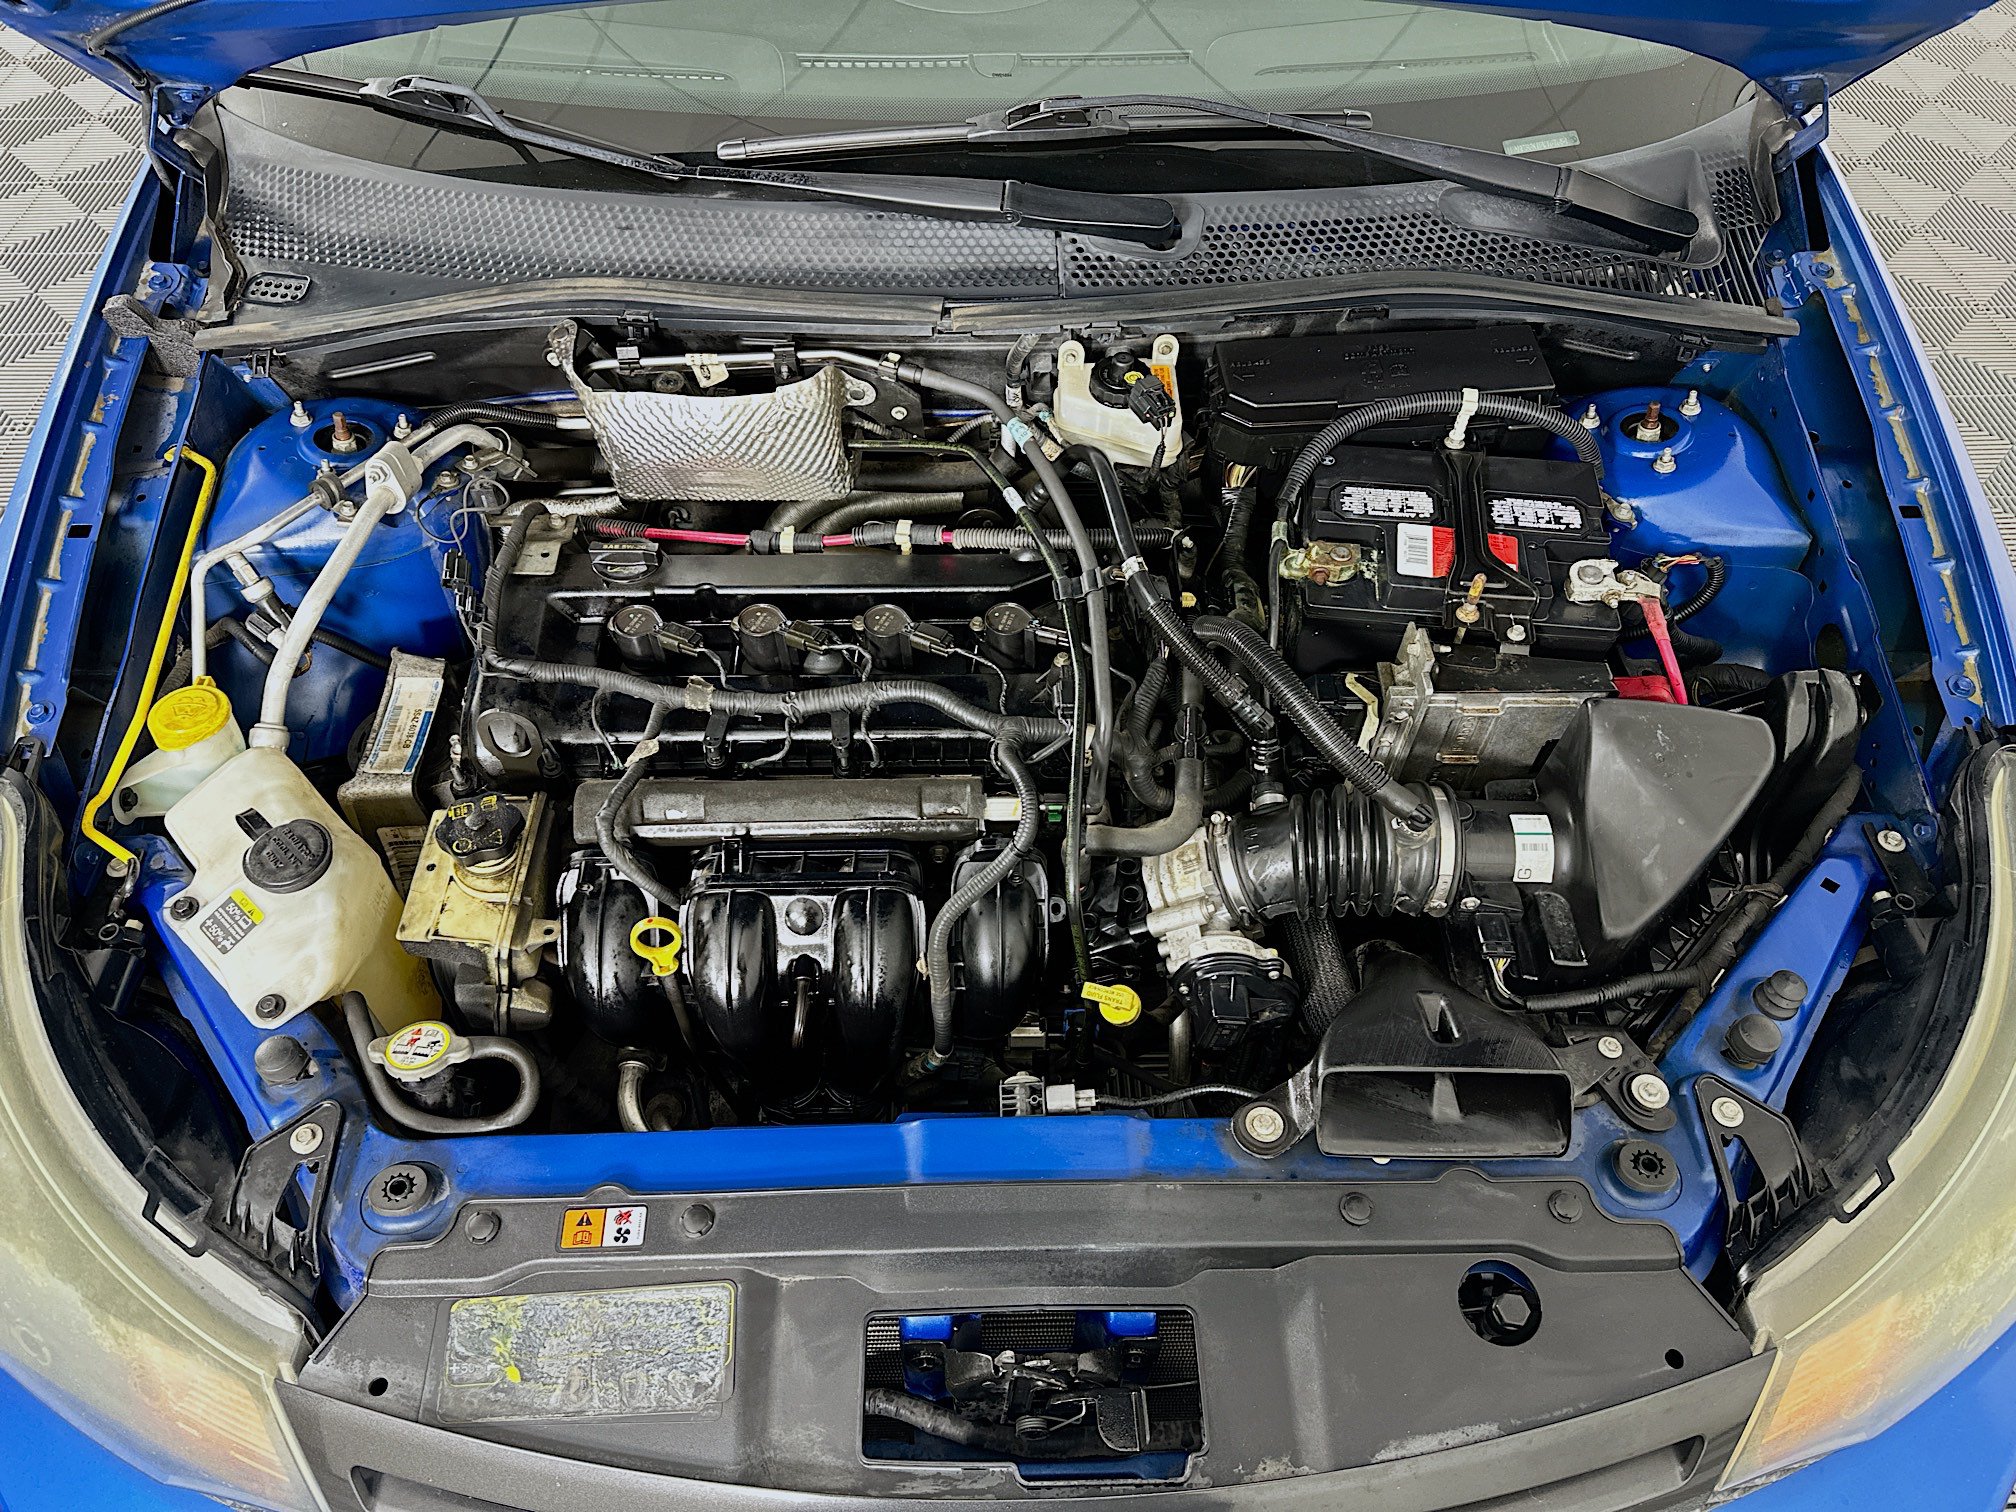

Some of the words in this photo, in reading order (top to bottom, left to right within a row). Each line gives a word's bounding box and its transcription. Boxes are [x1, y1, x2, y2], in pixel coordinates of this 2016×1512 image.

[282, 827, 316, 860] RADIATOR
[265, 850, 284, 869] ONLY
[225, 902, 243, 920] 50%
[1086, 991, 1103, 1000] FLUID
[1104, 996, 1123, 1005] TRANS
